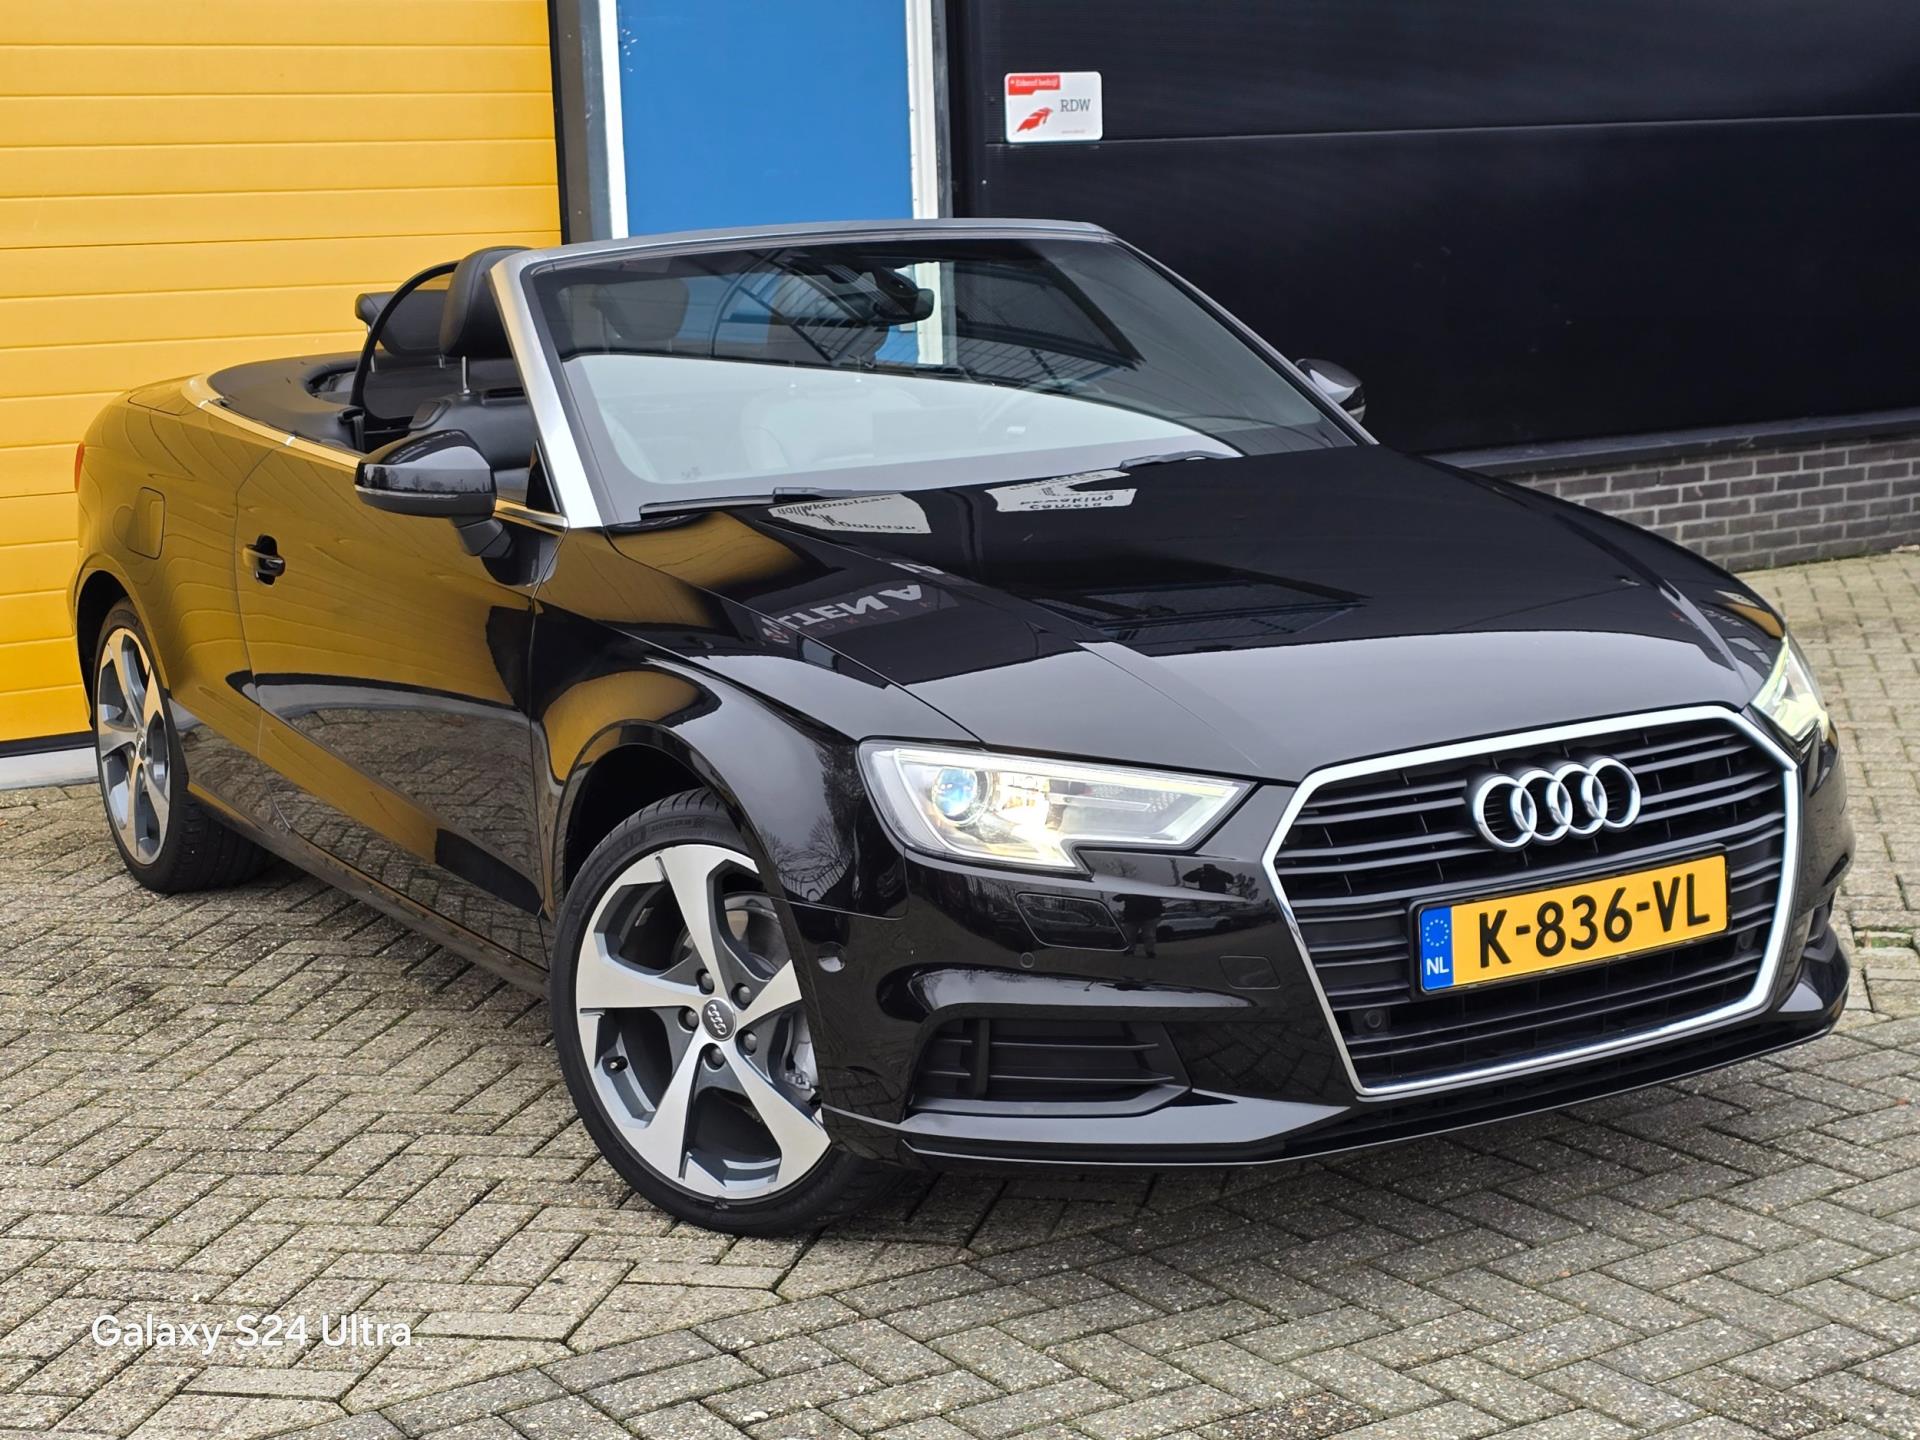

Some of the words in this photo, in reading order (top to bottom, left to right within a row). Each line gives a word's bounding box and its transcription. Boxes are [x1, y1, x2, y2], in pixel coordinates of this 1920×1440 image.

[1060, 98, 1091, 112] RDW
[1479, 873, 1710, 969] K-836-VL
[1426, 958, 1449, 976] NL
